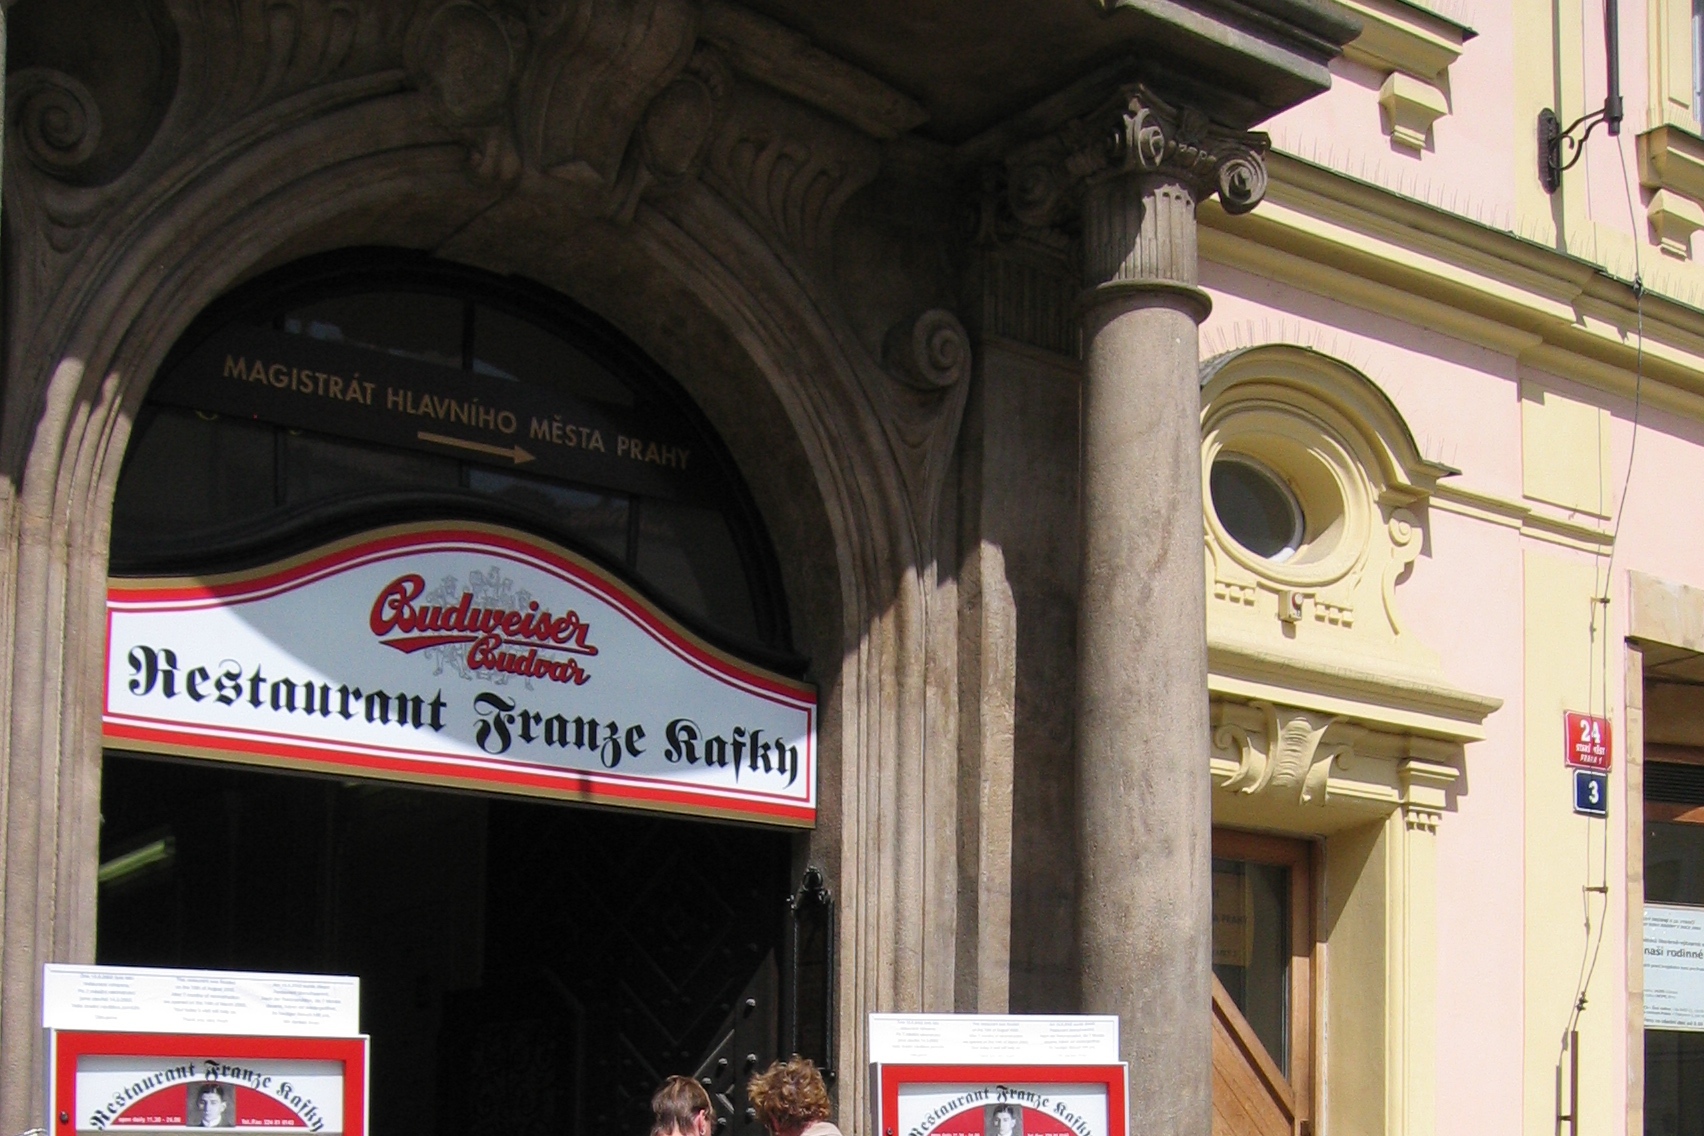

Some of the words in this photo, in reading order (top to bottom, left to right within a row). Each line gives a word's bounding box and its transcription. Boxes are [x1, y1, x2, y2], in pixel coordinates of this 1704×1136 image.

[222, 354, 376, 405] MAGISTRÁT
[387, 386, 518, 435] HLAVNÍHO
[529, 414, 606, 454] MĚSTA
[617, 436, 691, 470] PRAHY
[370, 573, 599, 655] Budweiser
[467, 633, 591, 686] Budvar
[127, 645, 447, 732] Restaurant
[473, 691, 647, 768] Franze
[664, 718, 798, 790] Kafky
[1580, 719, 1601, 743] 24
[1588, 780, 1599, 804] 3
[1644, 946, 1664, 956] naši
[1666, 948, 1704, 960] rodinné
[89, 1061, 196, 1131] Restaurant
[203, 1059, 273, 1090] Franze
[276, 1081, 325, 1132] Kafky
[995, 1084, 1050, 1109] Franze
